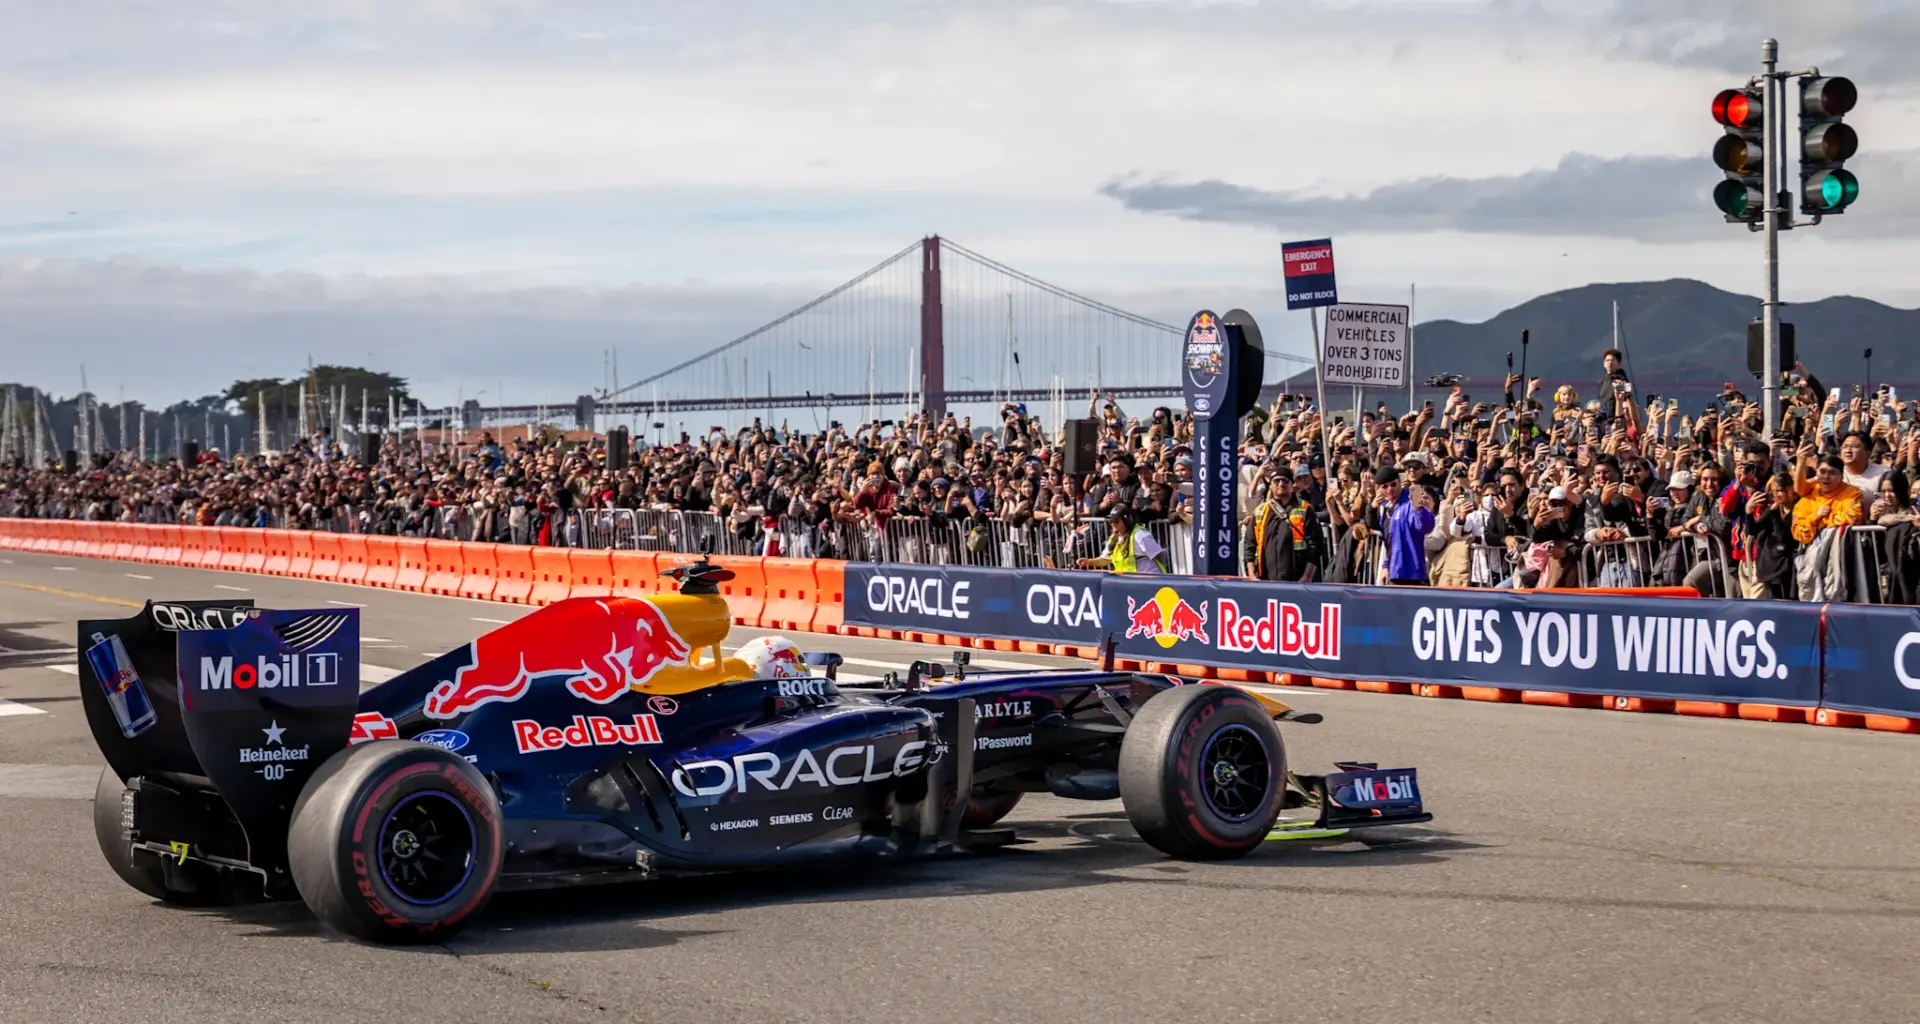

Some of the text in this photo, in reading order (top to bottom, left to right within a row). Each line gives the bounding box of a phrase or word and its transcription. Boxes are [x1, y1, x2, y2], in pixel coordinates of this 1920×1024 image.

[1284, 249, 1331, 262] EMERGENCY
[1300, 262, 1318, 272] EXIT
[1288, 290, 1335, 302] DO NOT BLOCK
[1329, 308, 1404, 325] COMMERCIAL
[1337, 329, 1395, 343] VEHICLES
[1327, 346, 1402, 362] OVER 3 TONS
[1327, 365, 1400, 381] PROHIBITED
[1197, 436, 1206, 558] CROSSING
[1218, 437, 1232, 559] CROSSING
[867, 574, 970, 619] ORACLE
[1026, 584, 1102, 629] ORA
[1412, 606, 1789, 681] GIVES YOU WIIINGS.
[200, 653, 299, 690] Mobil
[777, 679, 826, 696] ROKT
[974, 701, 1032, 718] ARLYLE
[978, 733, 1032, 751] 1Password
[239, 747, 309, 763] Heineken
[671, 740, 927, 797] ORACLE
[1354, 775, 1413, 802] Mobil
[719, 819, 759, 831] HEXAGON
[769, 812, 813, 825] SIEMENS
